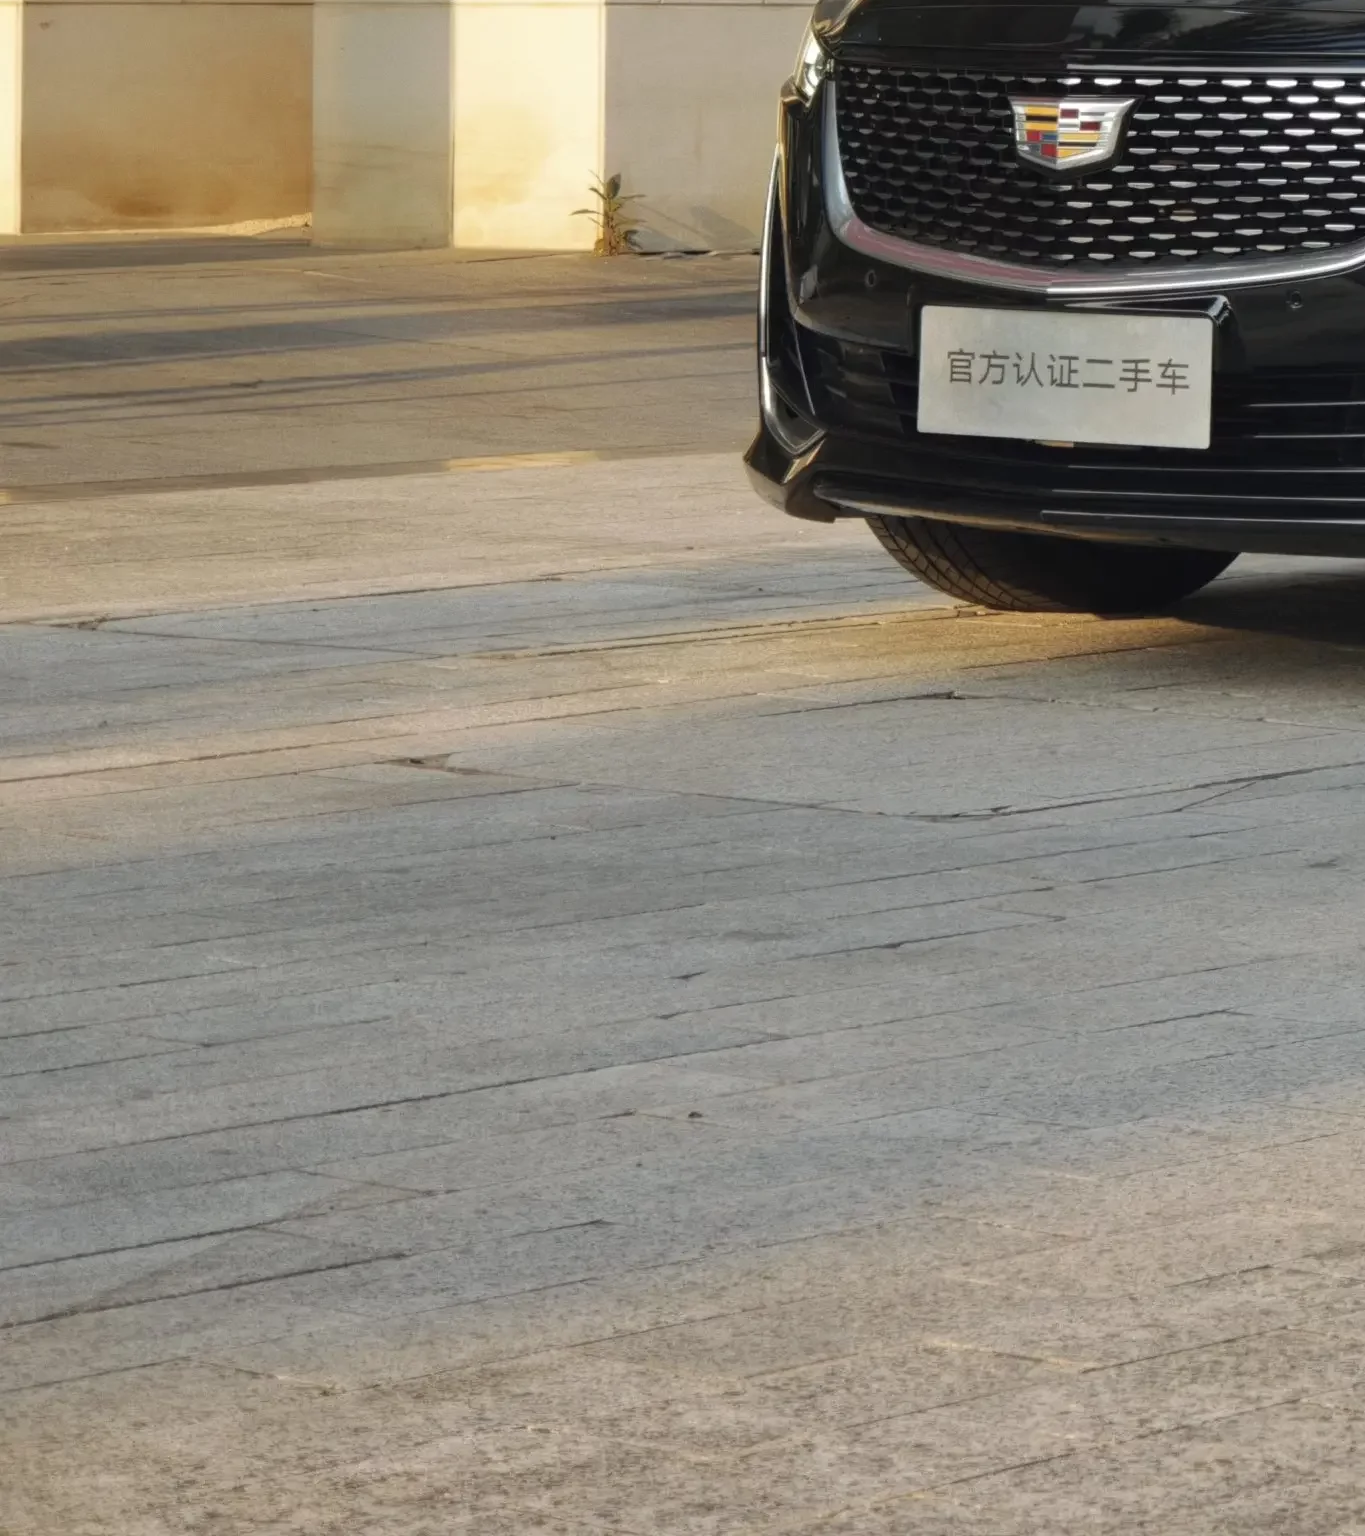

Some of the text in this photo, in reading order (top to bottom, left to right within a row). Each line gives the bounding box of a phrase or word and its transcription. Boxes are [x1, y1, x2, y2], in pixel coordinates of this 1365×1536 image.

[947, 348, 1190, 395] 官方认证二手车
